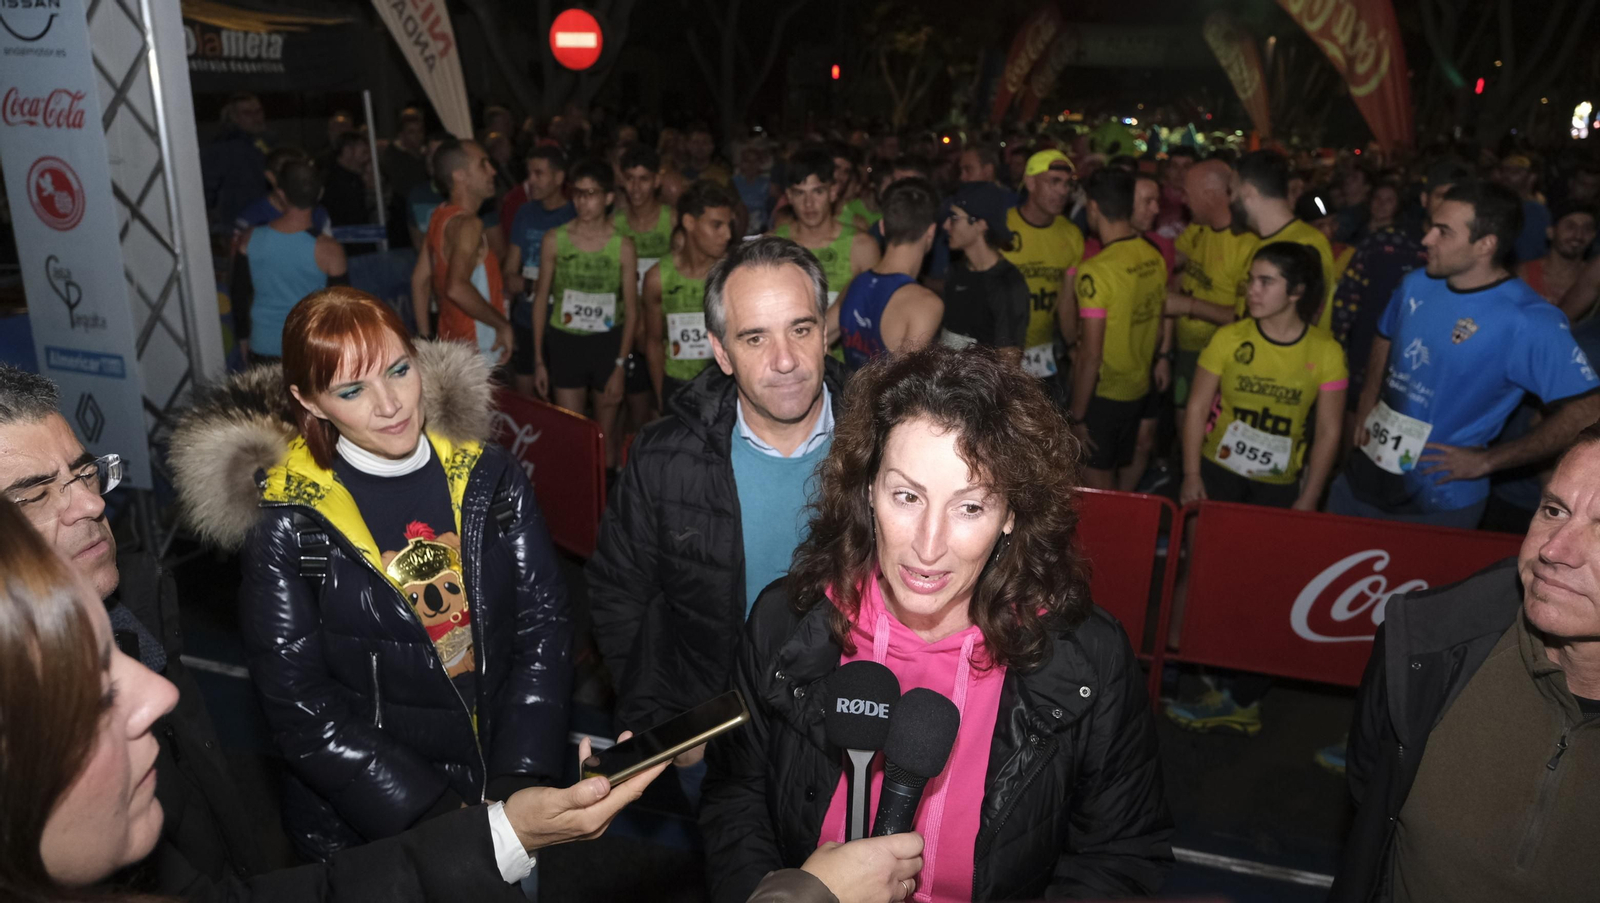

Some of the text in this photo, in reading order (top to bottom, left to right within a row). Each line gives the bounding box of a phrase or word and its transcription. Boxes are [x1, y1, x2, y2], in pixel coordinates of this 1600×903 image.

[573, 304, 603, 319] 209
[1233, 407, 1292, 437] mtp
[1372, 421, 1402, 451] 961
[1235, 440, 1274, 466] 955
[836, 697, 890, 719] RØDE
